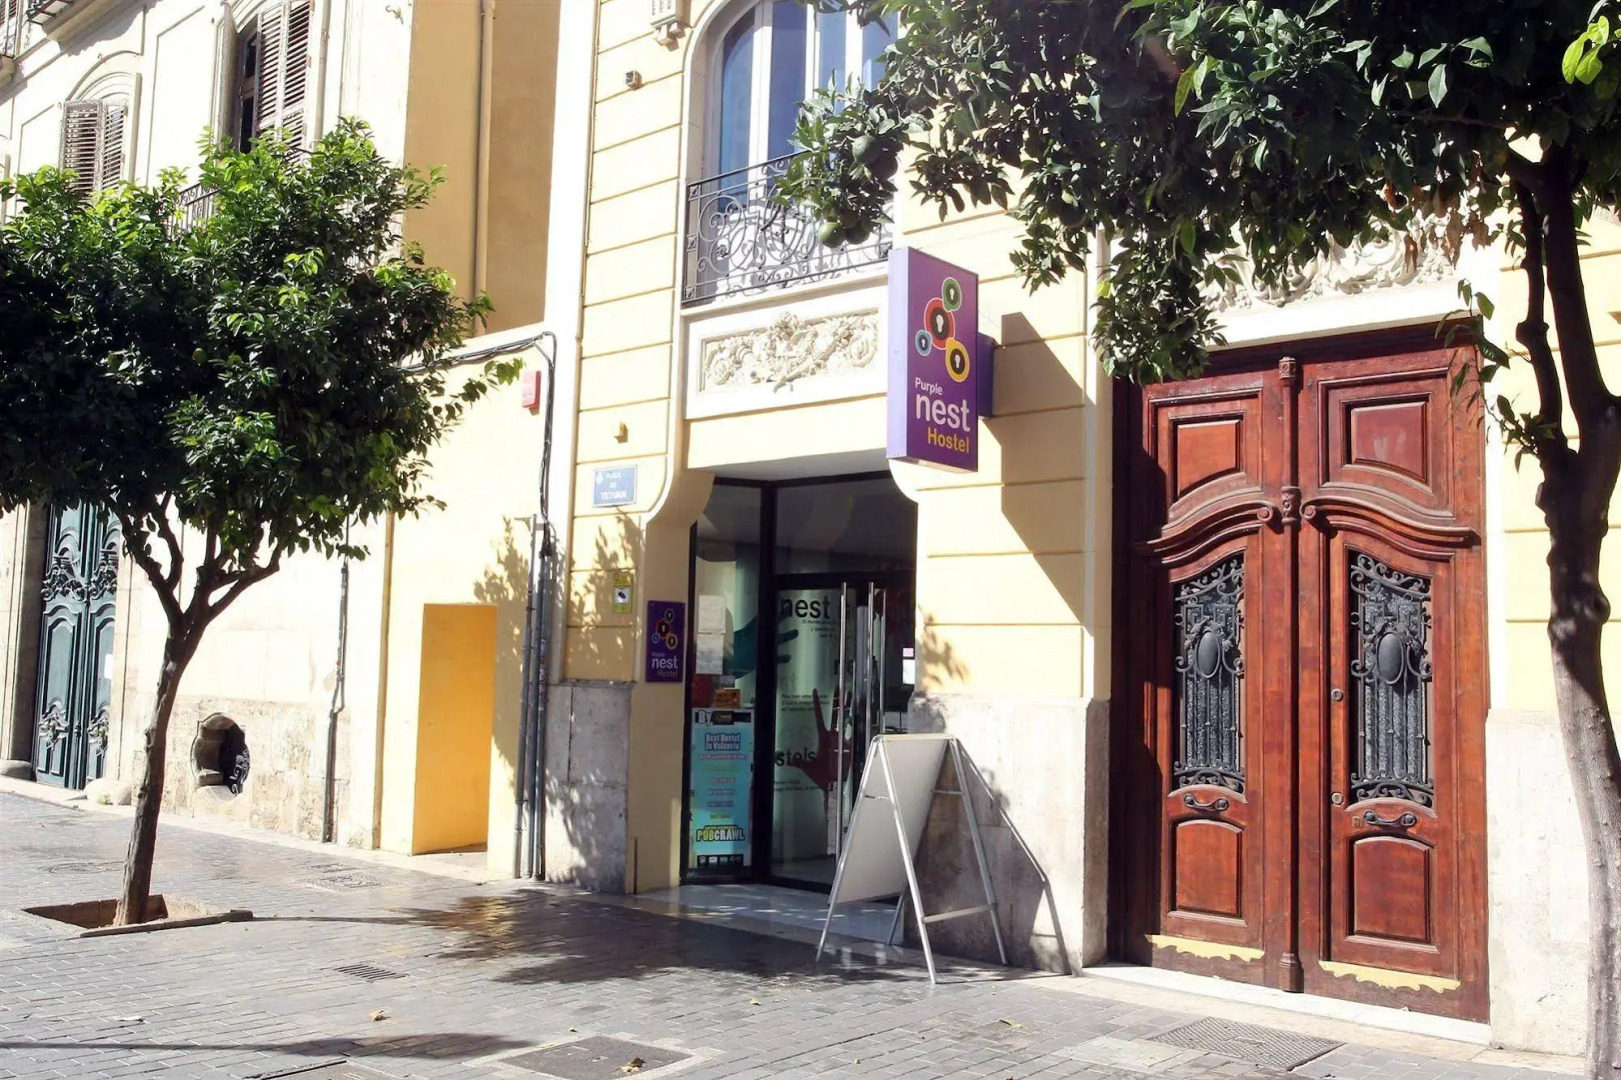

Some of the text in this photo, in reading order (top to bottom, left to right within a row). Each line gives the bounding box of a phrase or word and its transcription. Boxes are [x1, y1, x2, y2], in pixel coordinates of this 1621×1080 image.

[915, 377, 943, 395] Purple
[916, 393, 970, 432] nest
[927, 426, 969, 453] Hostel
[780, 596, 831, 619] nest
[651, 655, 679, 669] nest
